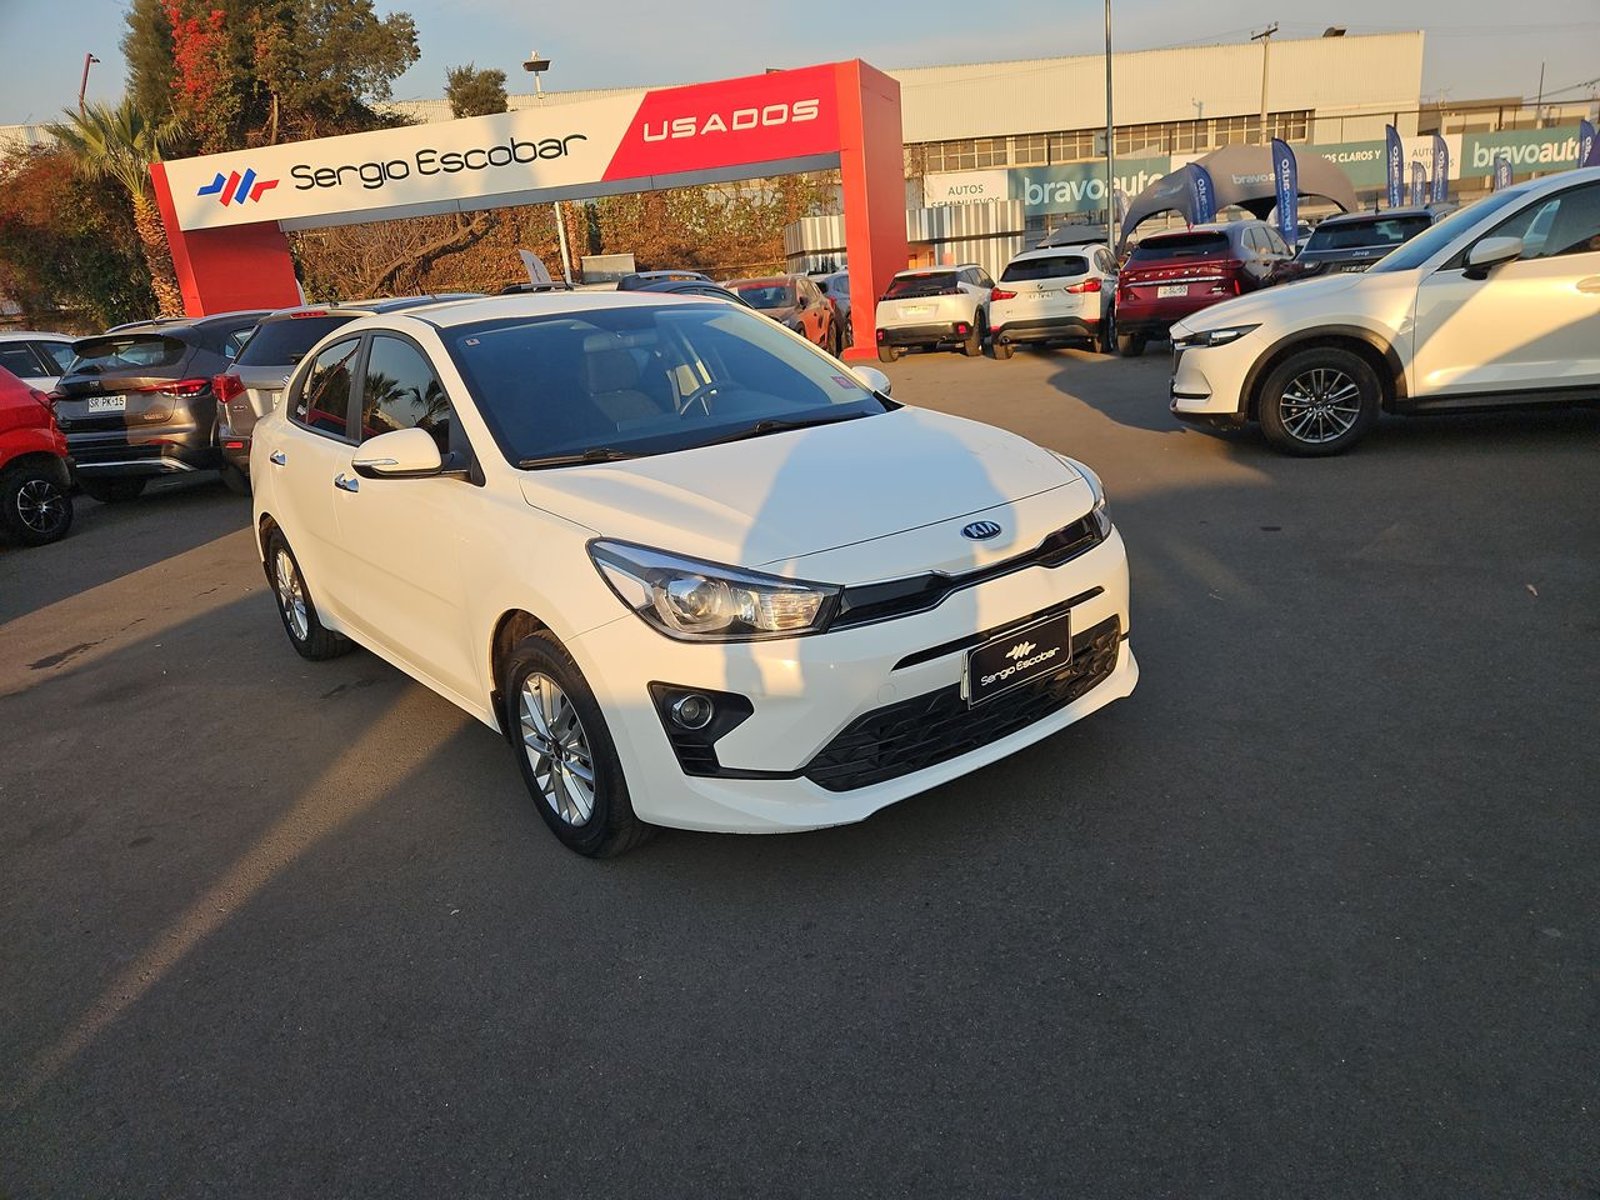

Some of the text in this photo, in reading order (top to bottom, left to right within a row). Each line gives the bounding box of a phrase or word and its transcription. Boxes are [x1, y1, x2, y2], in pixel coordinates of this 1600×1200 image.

[643, 99, 820, 142] USADOS
[290, 134, 588, 190] Sergio Escobar
[1338, 150, 1373, 163] CLAROS
[1374, 150, 1381, 160] Y
[948, 184, 984, 196] AUTOS
[969, 521, 999, 537] KIA
[1016, 647, 1060, 671] Escobar
